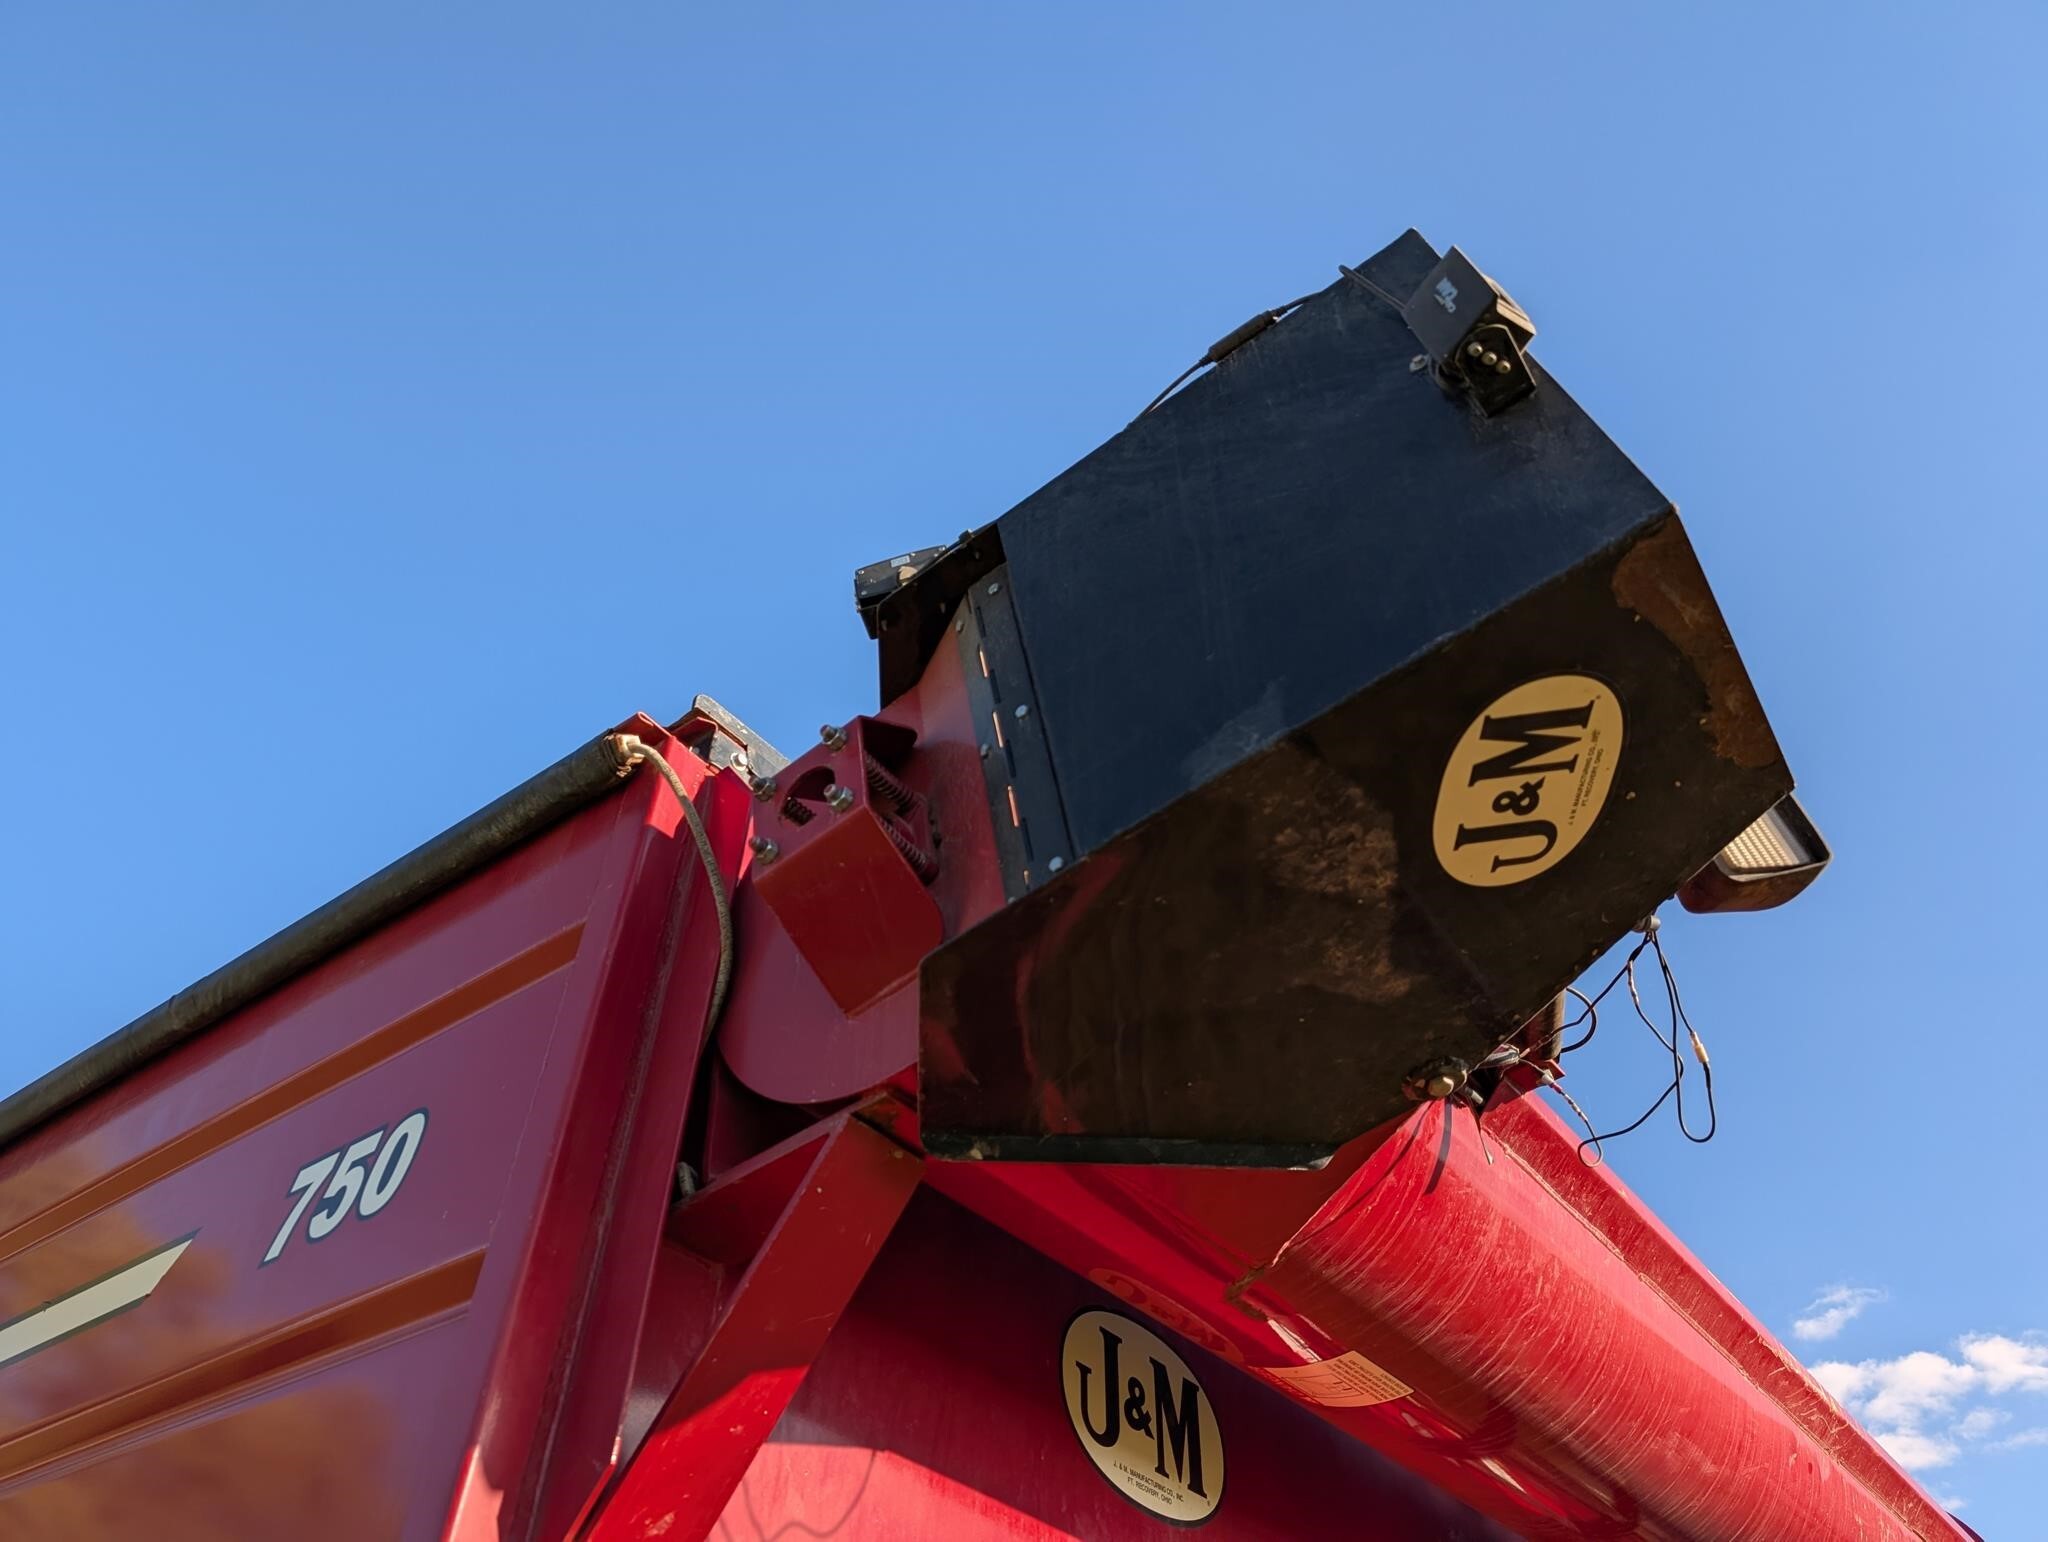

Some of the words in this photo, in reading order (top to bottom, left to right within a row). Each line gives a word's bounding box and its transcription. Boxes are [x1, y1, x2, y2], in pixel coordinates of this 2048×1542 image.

[1453, 699, 1596, 873] J&M
[1572, 757, 1593, 807] MANUFACTURING
[258, 1107, 428, 1268] 750
[1076, 1325, 1208, 1499] J&M
[1129, 1467, 1167, 1494] MANUFACTURING
[1160, 1493, 1173, 1505] OHIO
